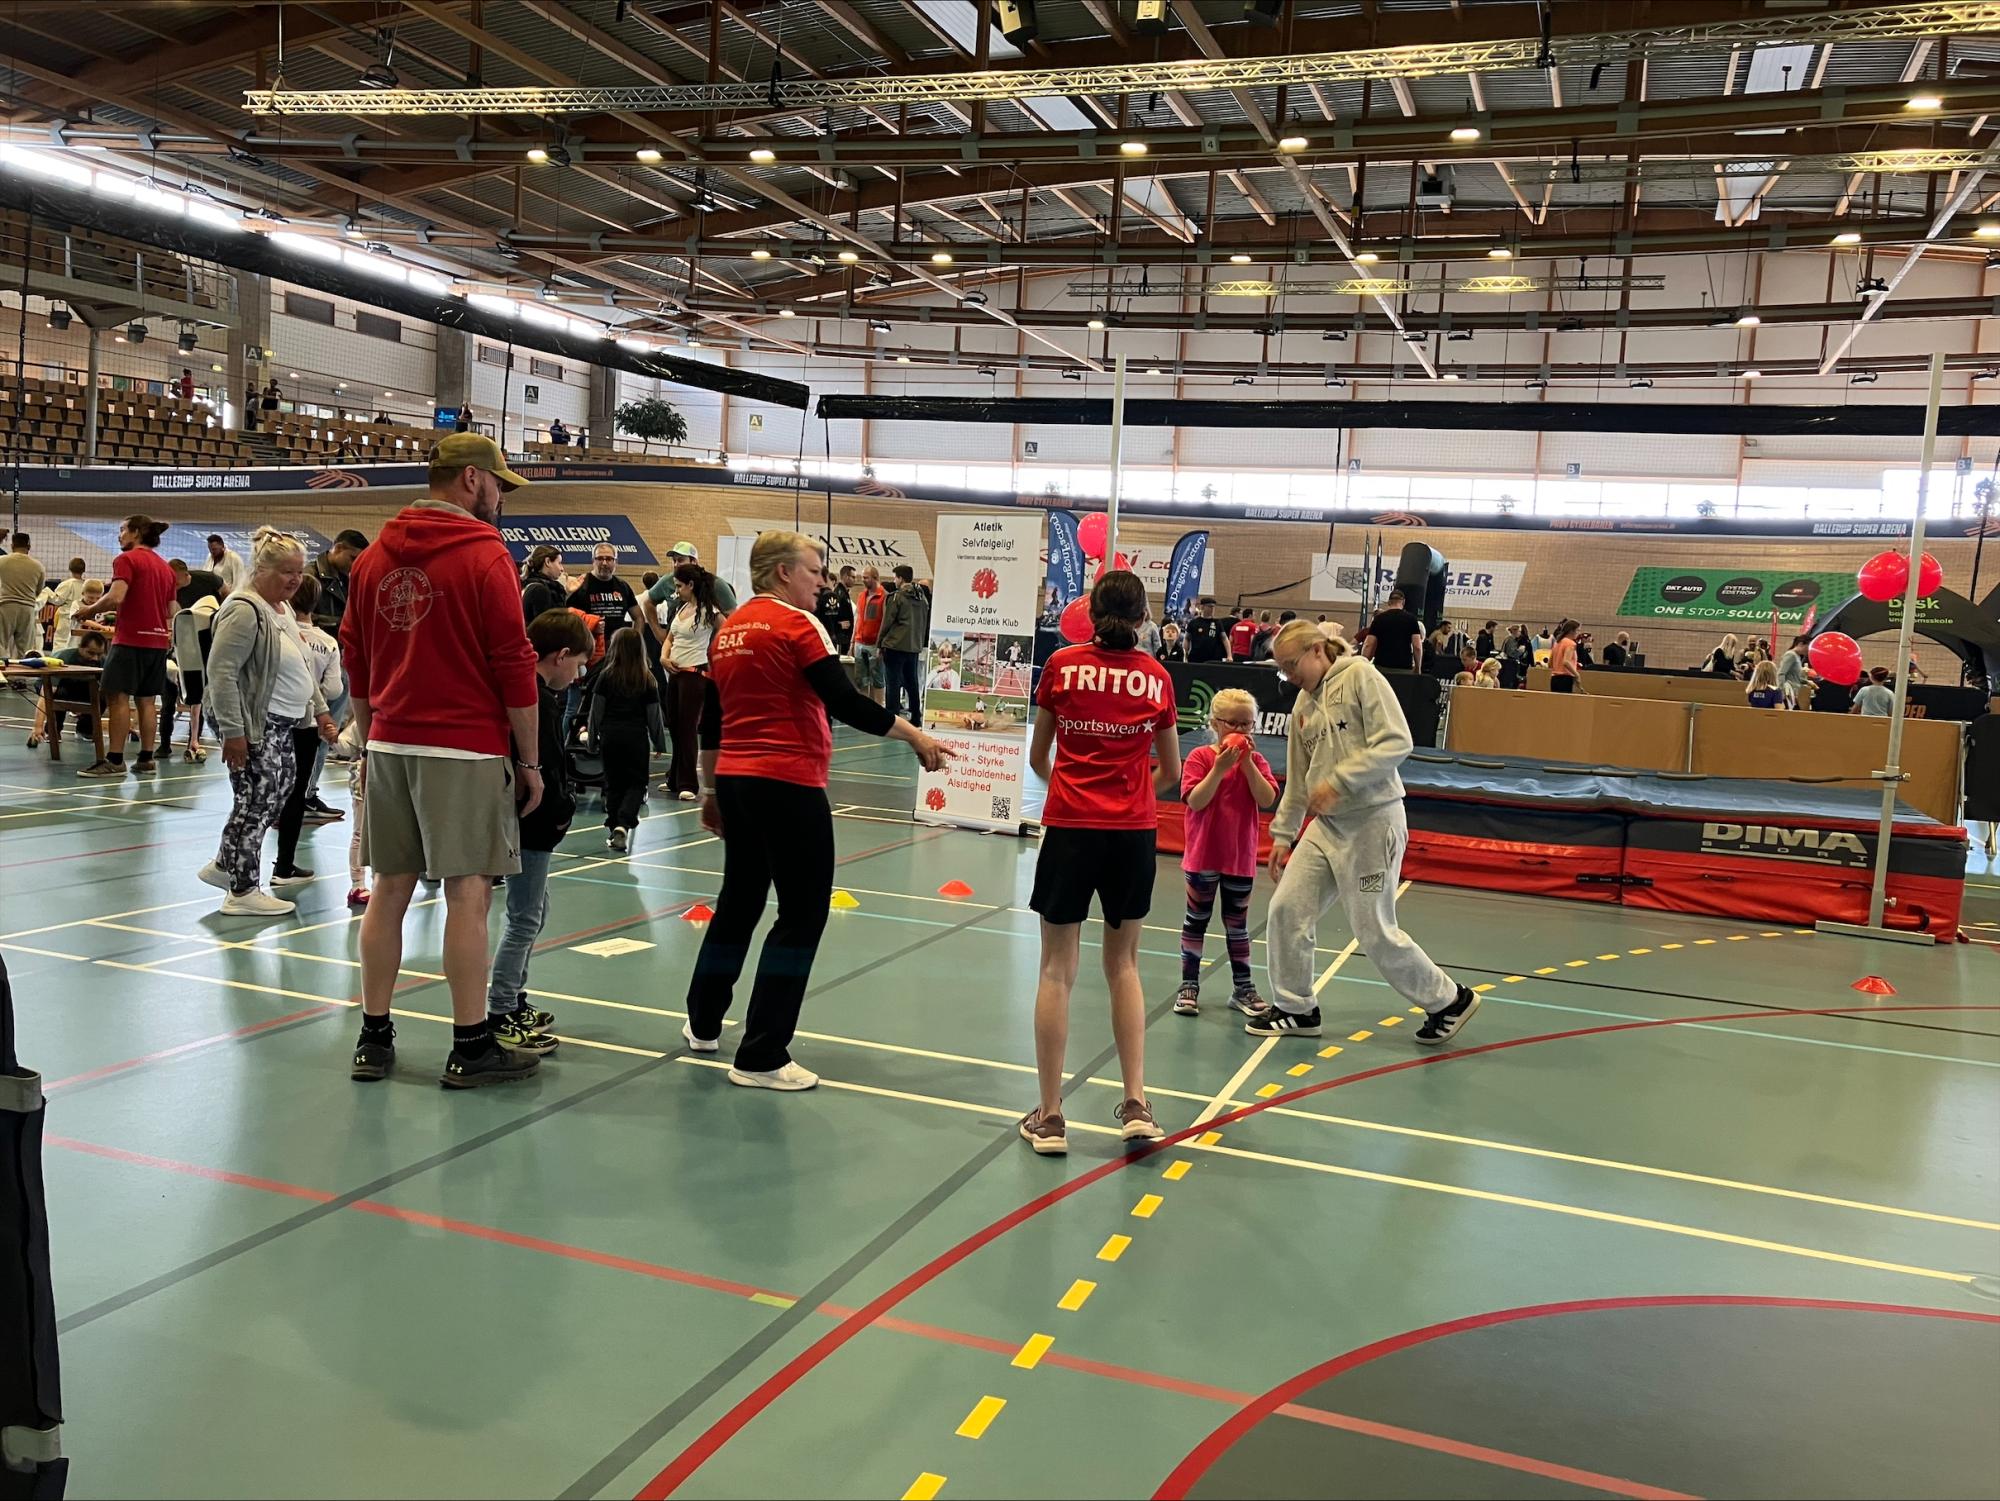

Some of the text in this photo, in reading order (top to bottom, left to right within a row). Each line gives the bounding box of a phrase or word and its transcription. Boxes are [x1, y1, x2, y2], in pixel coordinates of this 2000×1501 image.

[152, 475, 250, 488] BALLERUP SUPER ARENA
[733, 474, 766, 485] BALLERUP
[766, 475, 787, 487] SUPER
[1245, 508, 1324, 520] BALLERUP SUPER ARENA
[528, 527, 611, 541] BALLERUP
[973, 522, 1003, 532] Atletik
[1813, 523, 1907, 534] BALLERUP SUPER ARENA
[962, 538, 1014, 550] Selvfølgelig!
[1170, 534, 1206, 601] DragonFactory
[969, 604, 998, 615] Så prøv
[1654, 606, 1685, 614] ONE
[1688, 607, 1725, 617] STOP
[1727, 609, 1802, 621] SOLUTON
[946, 615, 1019, 627] Ballerup Atletik Klub
[718, 631, 748, 650] BAK
[1060, 664, 1163, 704] TRITON
[1057, 714, 1141, 735] Sportswear
[978, 742, 1020, 756] Hurtighed
[945, 753, 969, 763] otorik
[977, 755, 1005, 768] Styrke
[960, 767, 1017, 782] Udholdenhed
[947, 778, 991, 792] Alsidighed
[1702, 822, 1868, 855] DIMA
